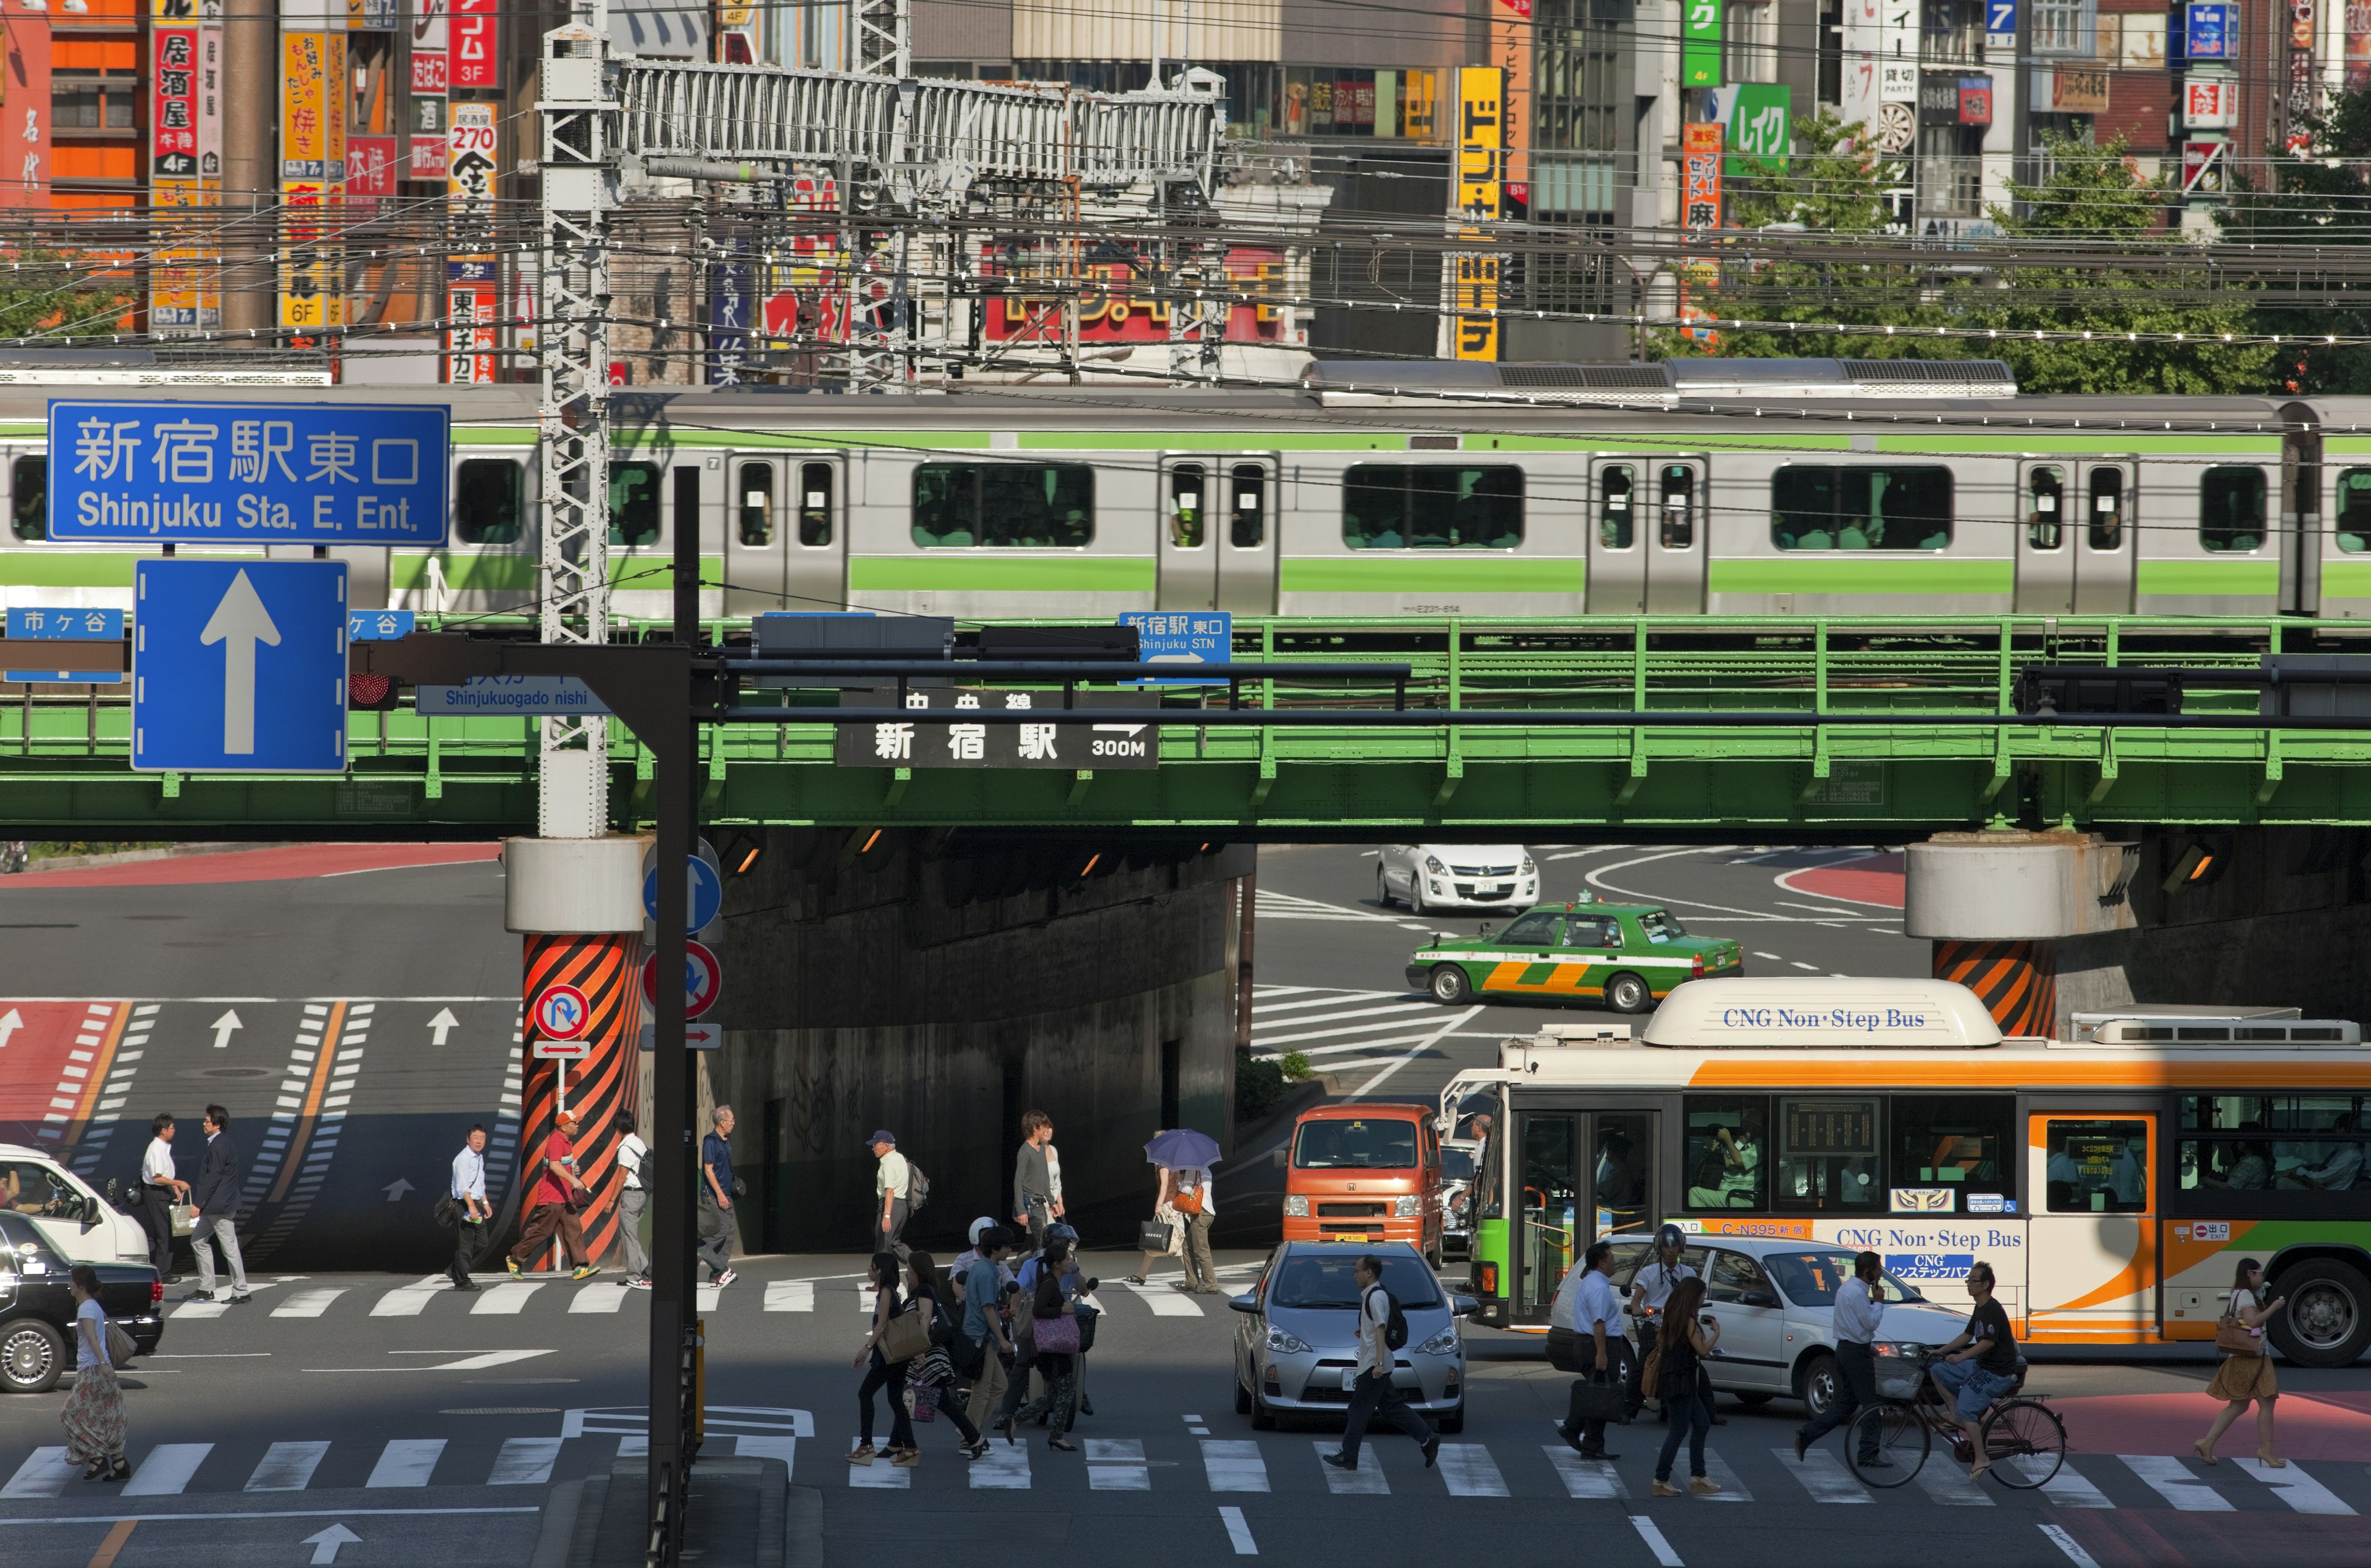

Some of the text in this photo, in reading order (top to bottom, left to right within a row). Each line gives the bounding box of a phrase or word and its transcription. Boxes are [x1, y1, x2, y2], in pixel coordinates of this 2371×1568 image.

[1691, 0, 1715, 30] ク
[160, 35, 193, 128] 居酒屋
[412, 59, 445, 88] たばこ
[461, 65, 484, 81] 3F
[1885, 69, 1915, 82] 貸切
[1885, 85, 1914, 93] PARTY
[291, 107, 317, 156] 焼き
[453, 127, 494, 150] 270
[1738, 106, 1785, 156] レイク
[163, 154, 190, 172] 4F
[307, 161, 322, 176] 7F
[1689, 158, 1702, 199] セット
[1704, 153, 1718, 194] フリー
[292, 304, 314, 323] 6F
[73, 415, 420, 485] 新宿駅東口
[78, 491, 419, 535] Shinjuku Sta. E. Ent.
[1139, 638, 1187, 652] Shinjuku
[446, 690, 587, 707] Shinjukuogado nishi
[875, 722, 1146, 760] 新宿駅 300M
[1723, 1009, 1772, 1027] CNG
[1885, 1009, 1925, 1027] Bus
[1680, 1222, 1699, 1232] 入口
[2209, 1224, 2227, 1233] 出口
[1836, 1229, 1883, 1247] CNG
[1987, 1229, 2021, 1248] Bus
[1913, 1255, 1944, 1267] CNG
[1891, 1267, 1972, 1278] ノンステップバス
